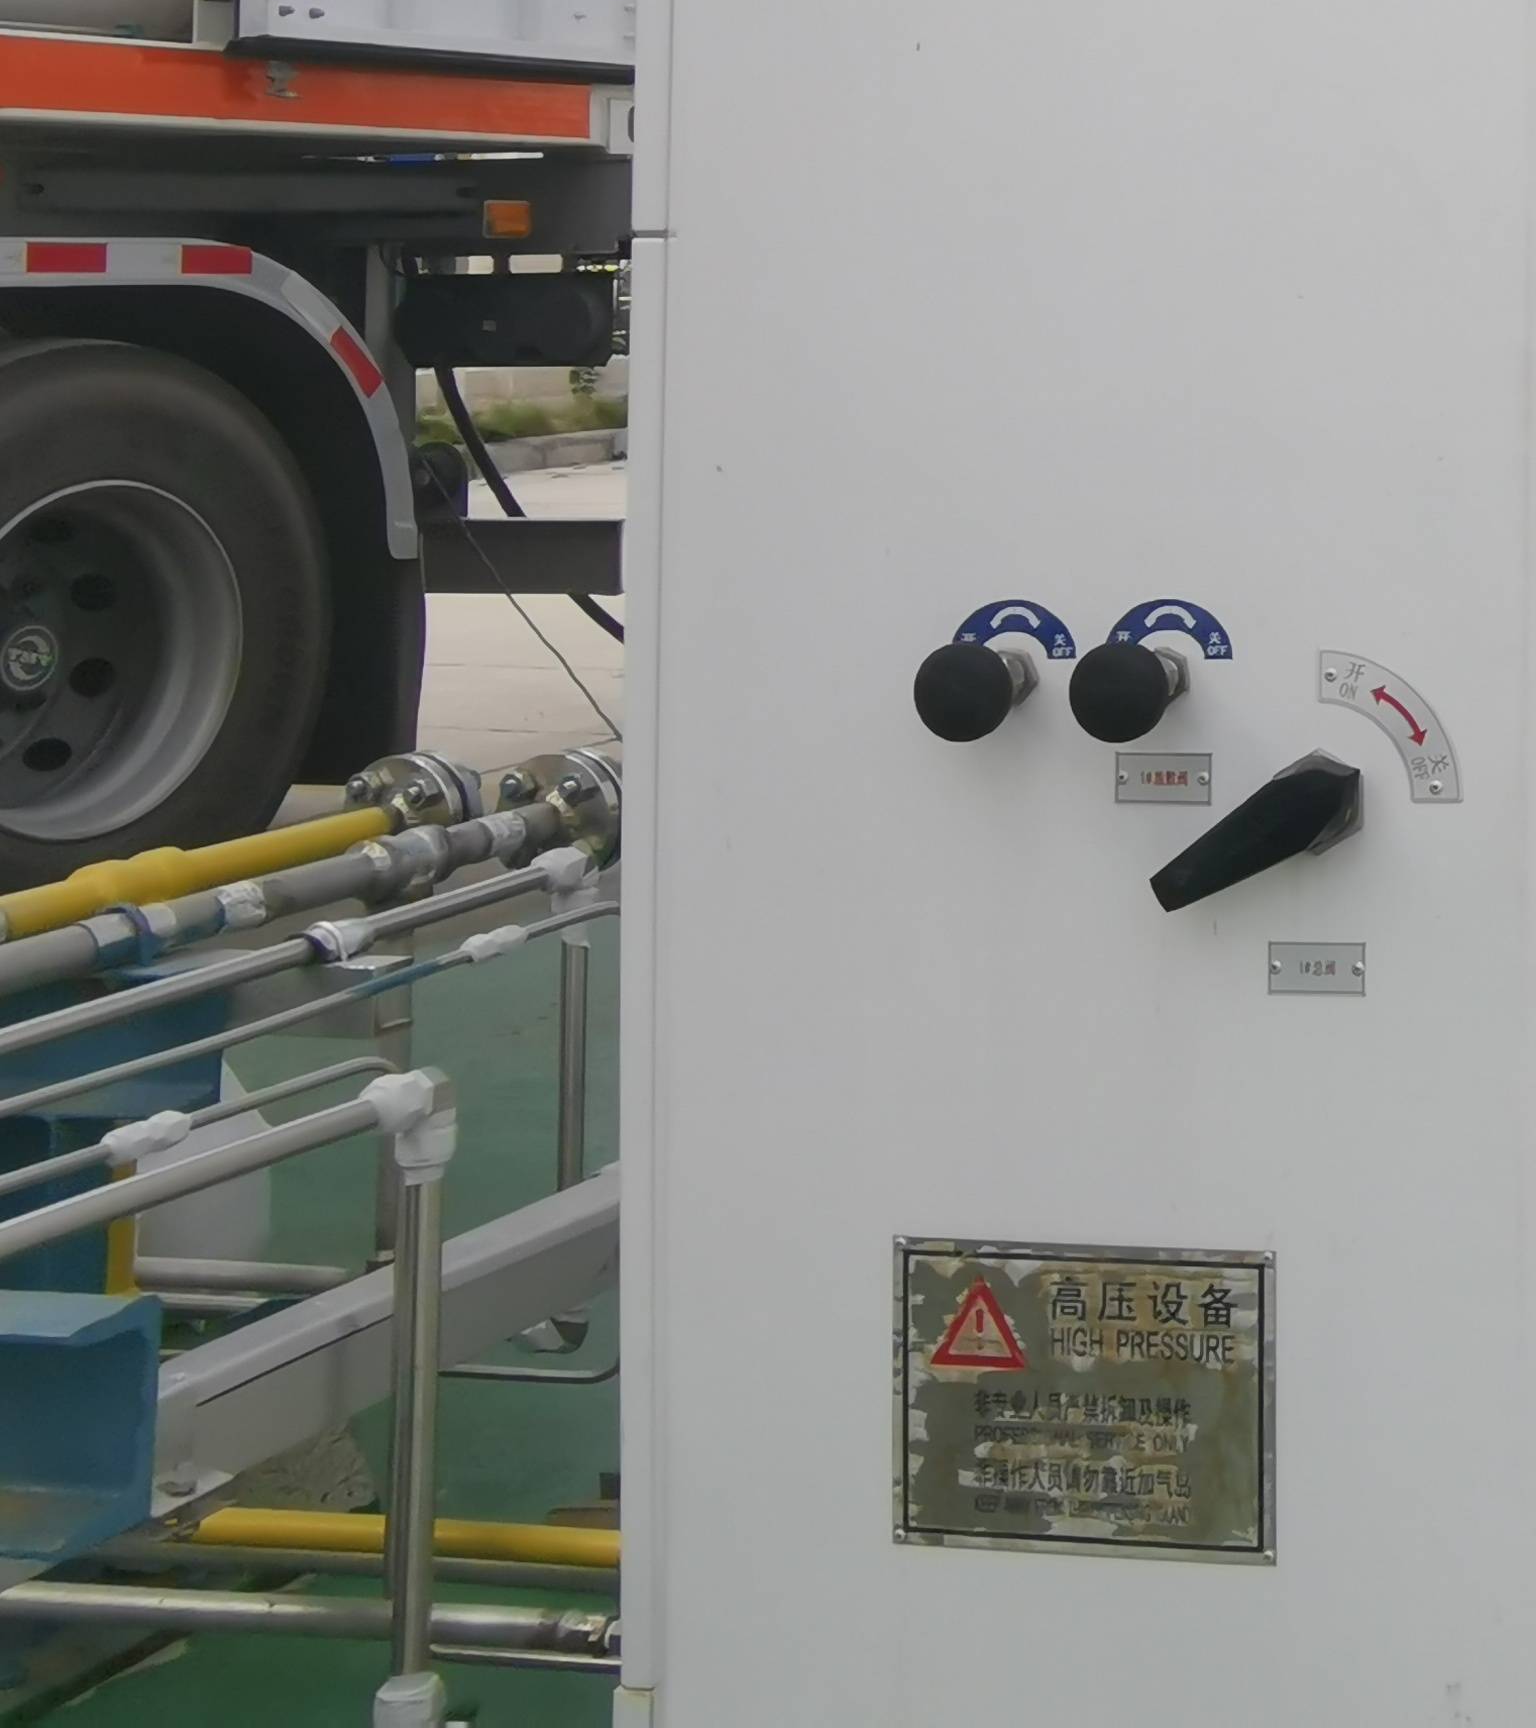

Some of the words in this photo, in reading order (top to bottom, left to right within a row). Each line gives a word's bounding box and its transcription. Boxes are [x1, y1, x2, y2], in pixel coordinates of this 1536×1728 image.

[1051, 646, 1074, 658] OFF
[1206, 644, 1229, 657] OFF
[1343, 660, 1367, 683] 开
[1338, 681, 1360, 701] ON
[1409, 755, 1432, 781] OFF
[1049, 1275, 1239, 1330] 高压设备
[1050, 1326, 1106, 1358] HIGH
[1116, 1329, 1236, 1365] PRESSURE
